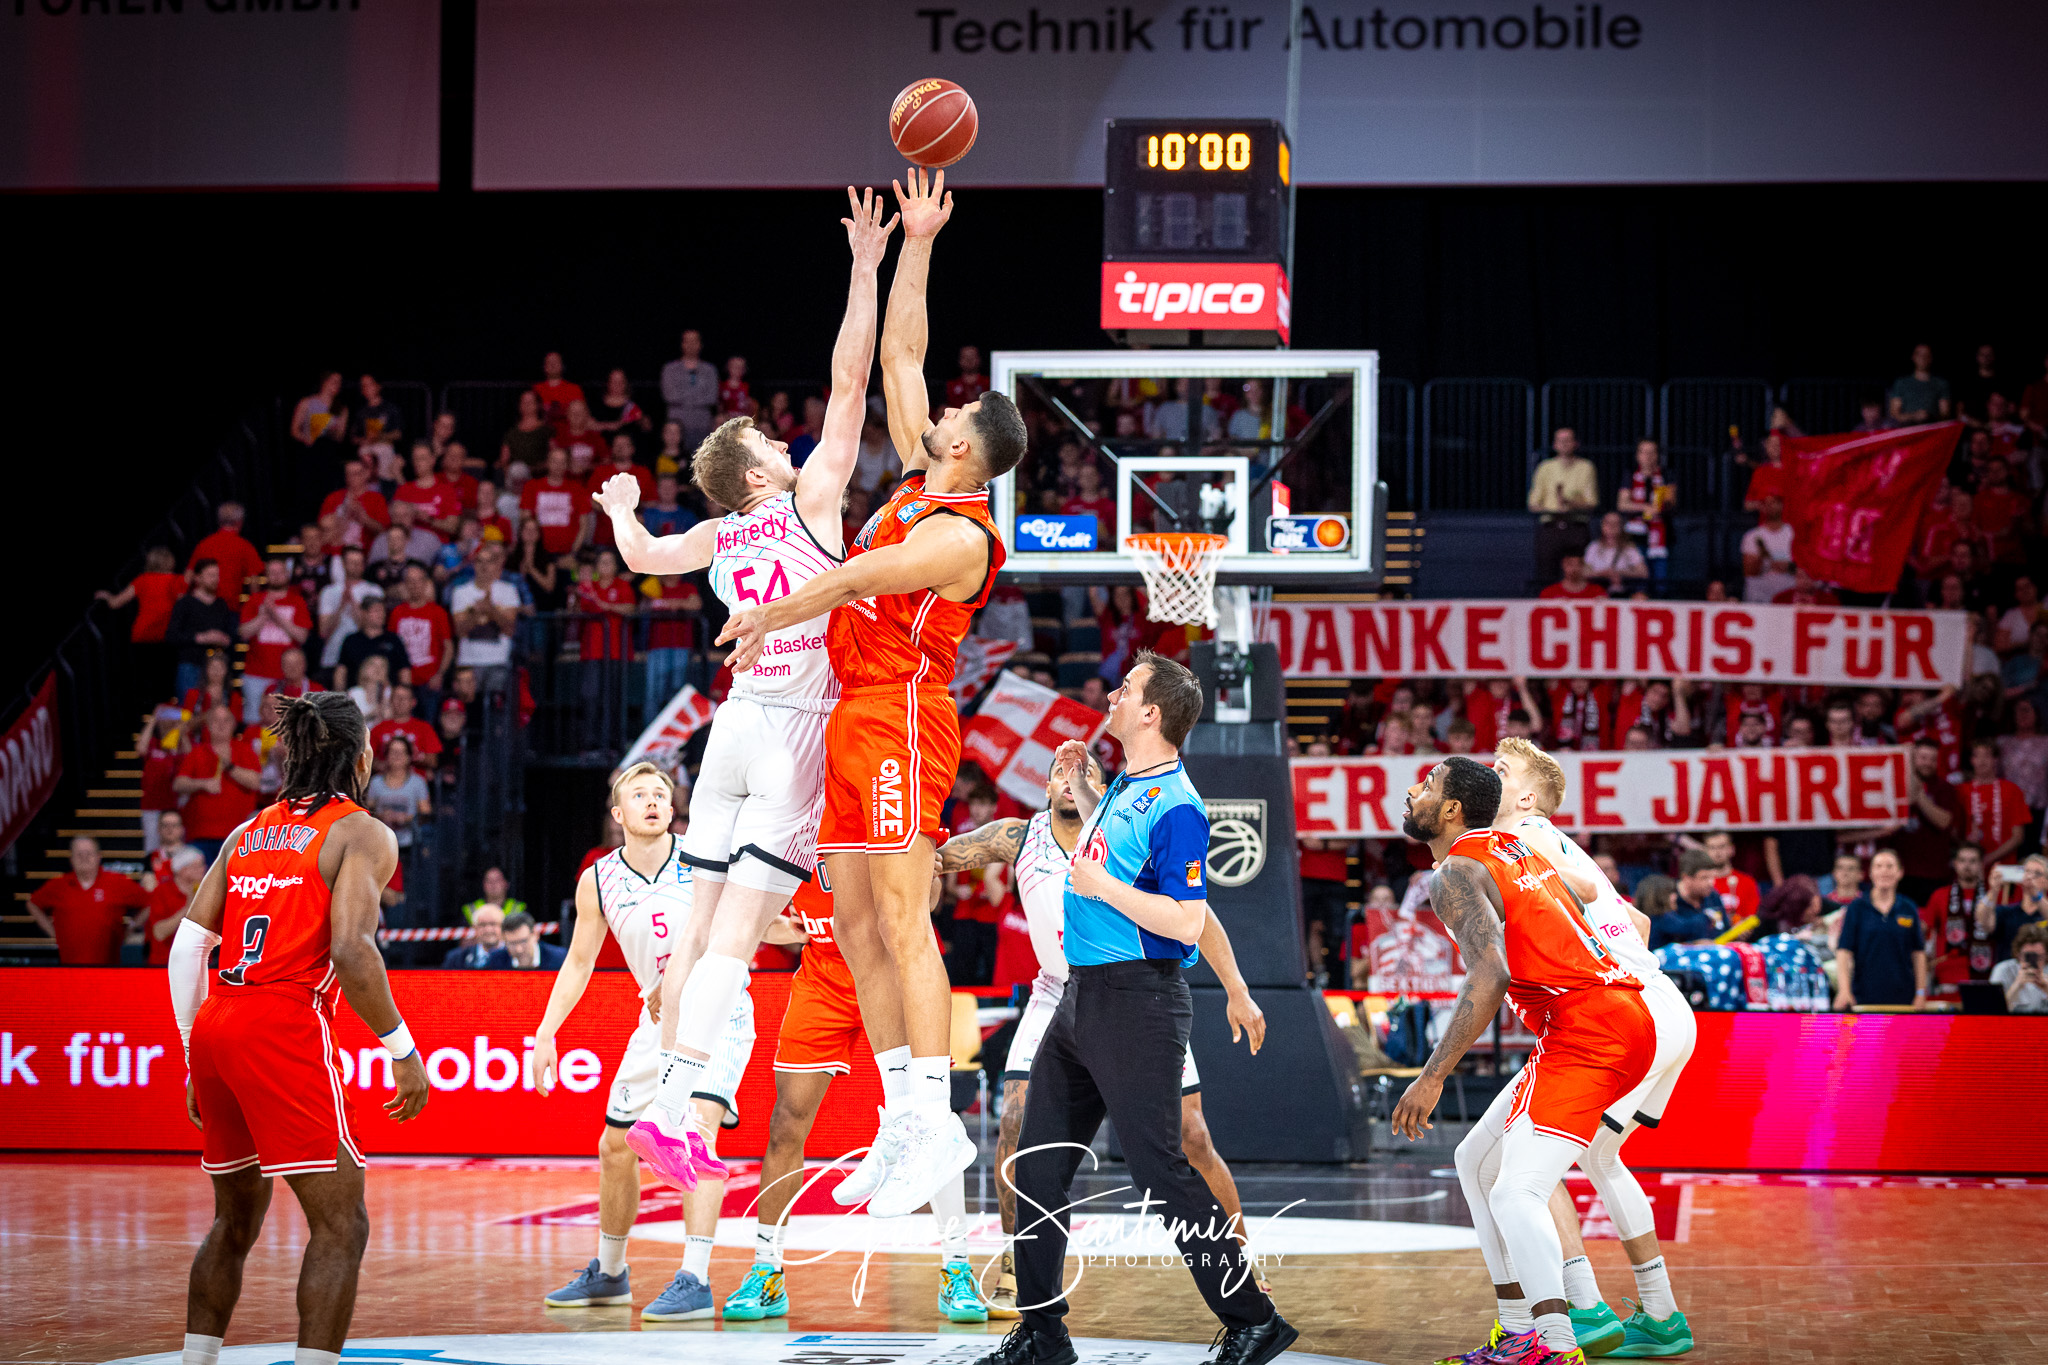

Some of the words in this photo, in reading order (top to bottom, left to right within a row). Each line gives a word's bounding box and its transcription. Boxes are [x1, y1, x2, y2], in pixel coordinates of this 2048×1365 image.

[917, 7, 1154, 53] Technik
[1179, 6, 1262, 51] für
[1283, 3, 1643, 50] Automobile
[892, 80, 942, 127] SPALDING
[1114, 270, 1266, 322] tipico
[732, 559, 792, 607] 54
[1253, 607, 1507, 672] DANKE
[752, 663, 791, 677] Bonn
[1652, 750, 1911, 826] JAHRE!
[238, 823, 320, 858] JOHNSON
[1112, 809, 1133, 825] SPALDING
[228, 872, 275, 899] xpd
[651, 912, 669, 939] 5
[64, 1031, 164, 1086] für
